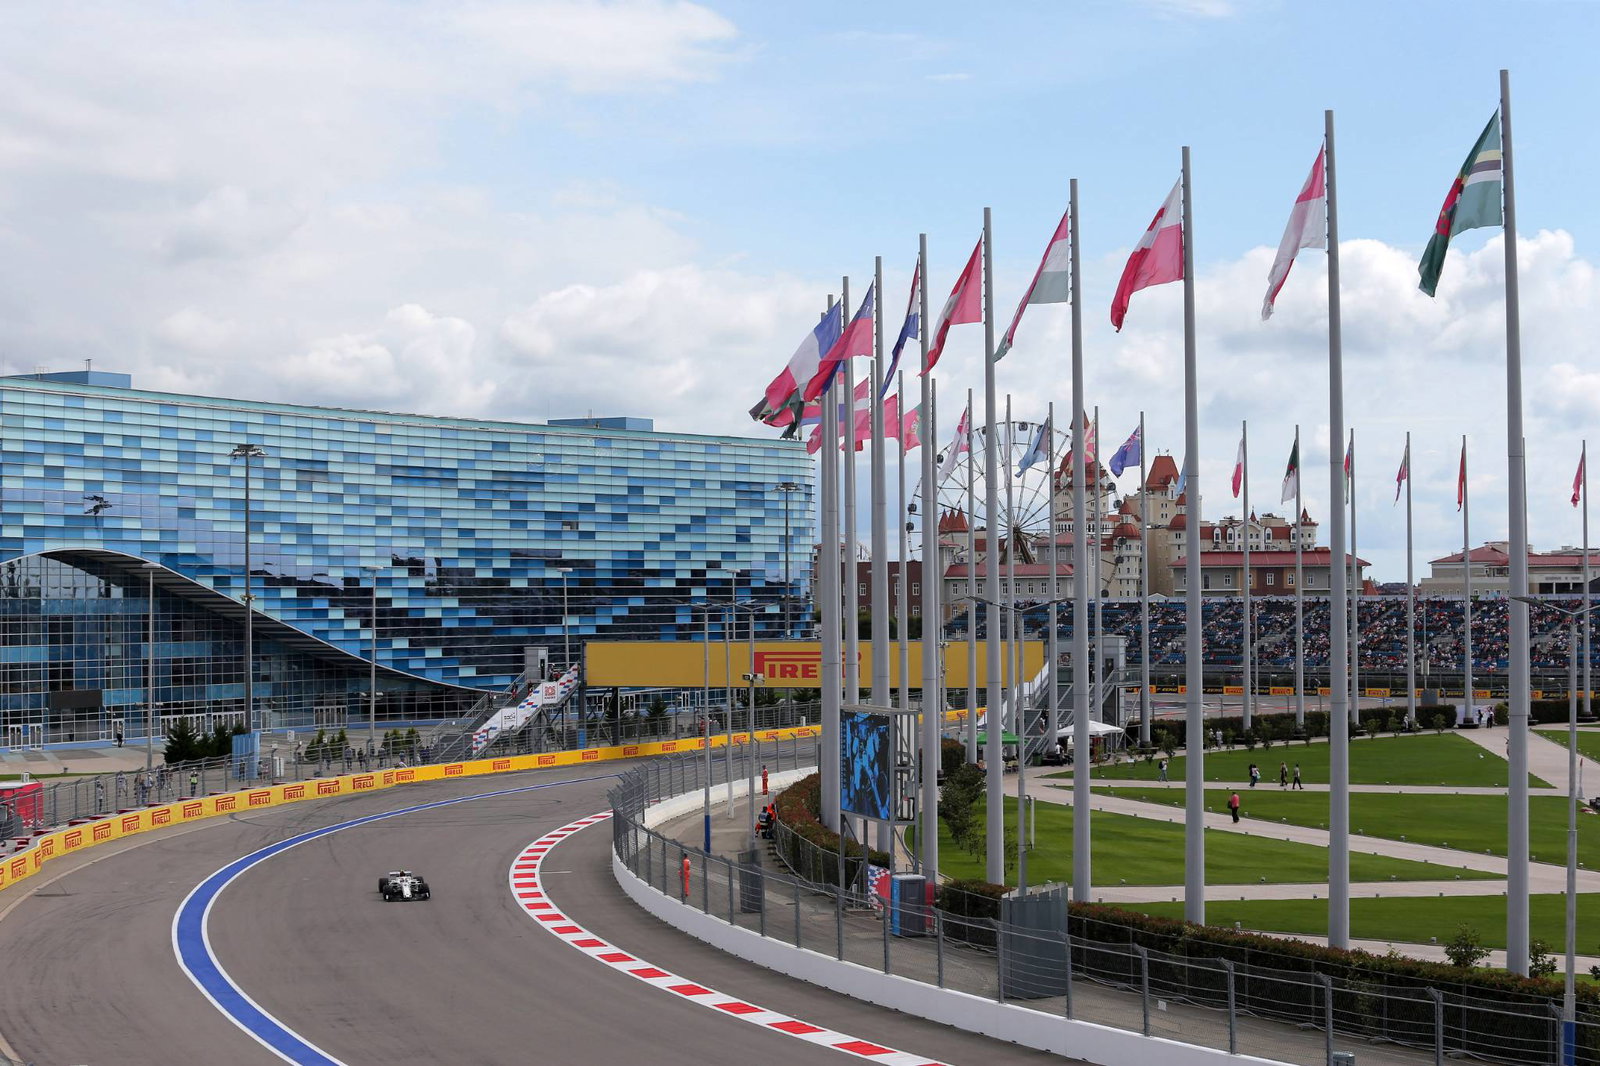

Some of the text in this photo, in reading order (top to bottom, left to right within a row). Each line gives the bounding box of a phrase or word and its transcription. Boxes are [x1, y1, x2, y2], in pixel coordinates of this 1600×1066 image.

[754, 651, 861, 679] PIRE
[396, 770, 415, 782] PIRELLI
[444, 764, 464, 776] PIRELLI
[317, 780, 340, 795] PIRELLI
[352, 775, 374, 790] PIRELLI
[248, 791, 271, 806] PIRELLI
[283, 785, 305, 800] PIRELLI
[183, 802, 203, 819] PIRELLI
[215, 796, 236, 812] PIRELLI
[122, 815, 140, 833] PIRELLI
[152, 808, 171, 826] PIRELLI
[64, 830, 82, 850] PIRELLI
[93, 823, 111, 842] PIRELLI
[11, 857, 27, 880] PIRELLI
